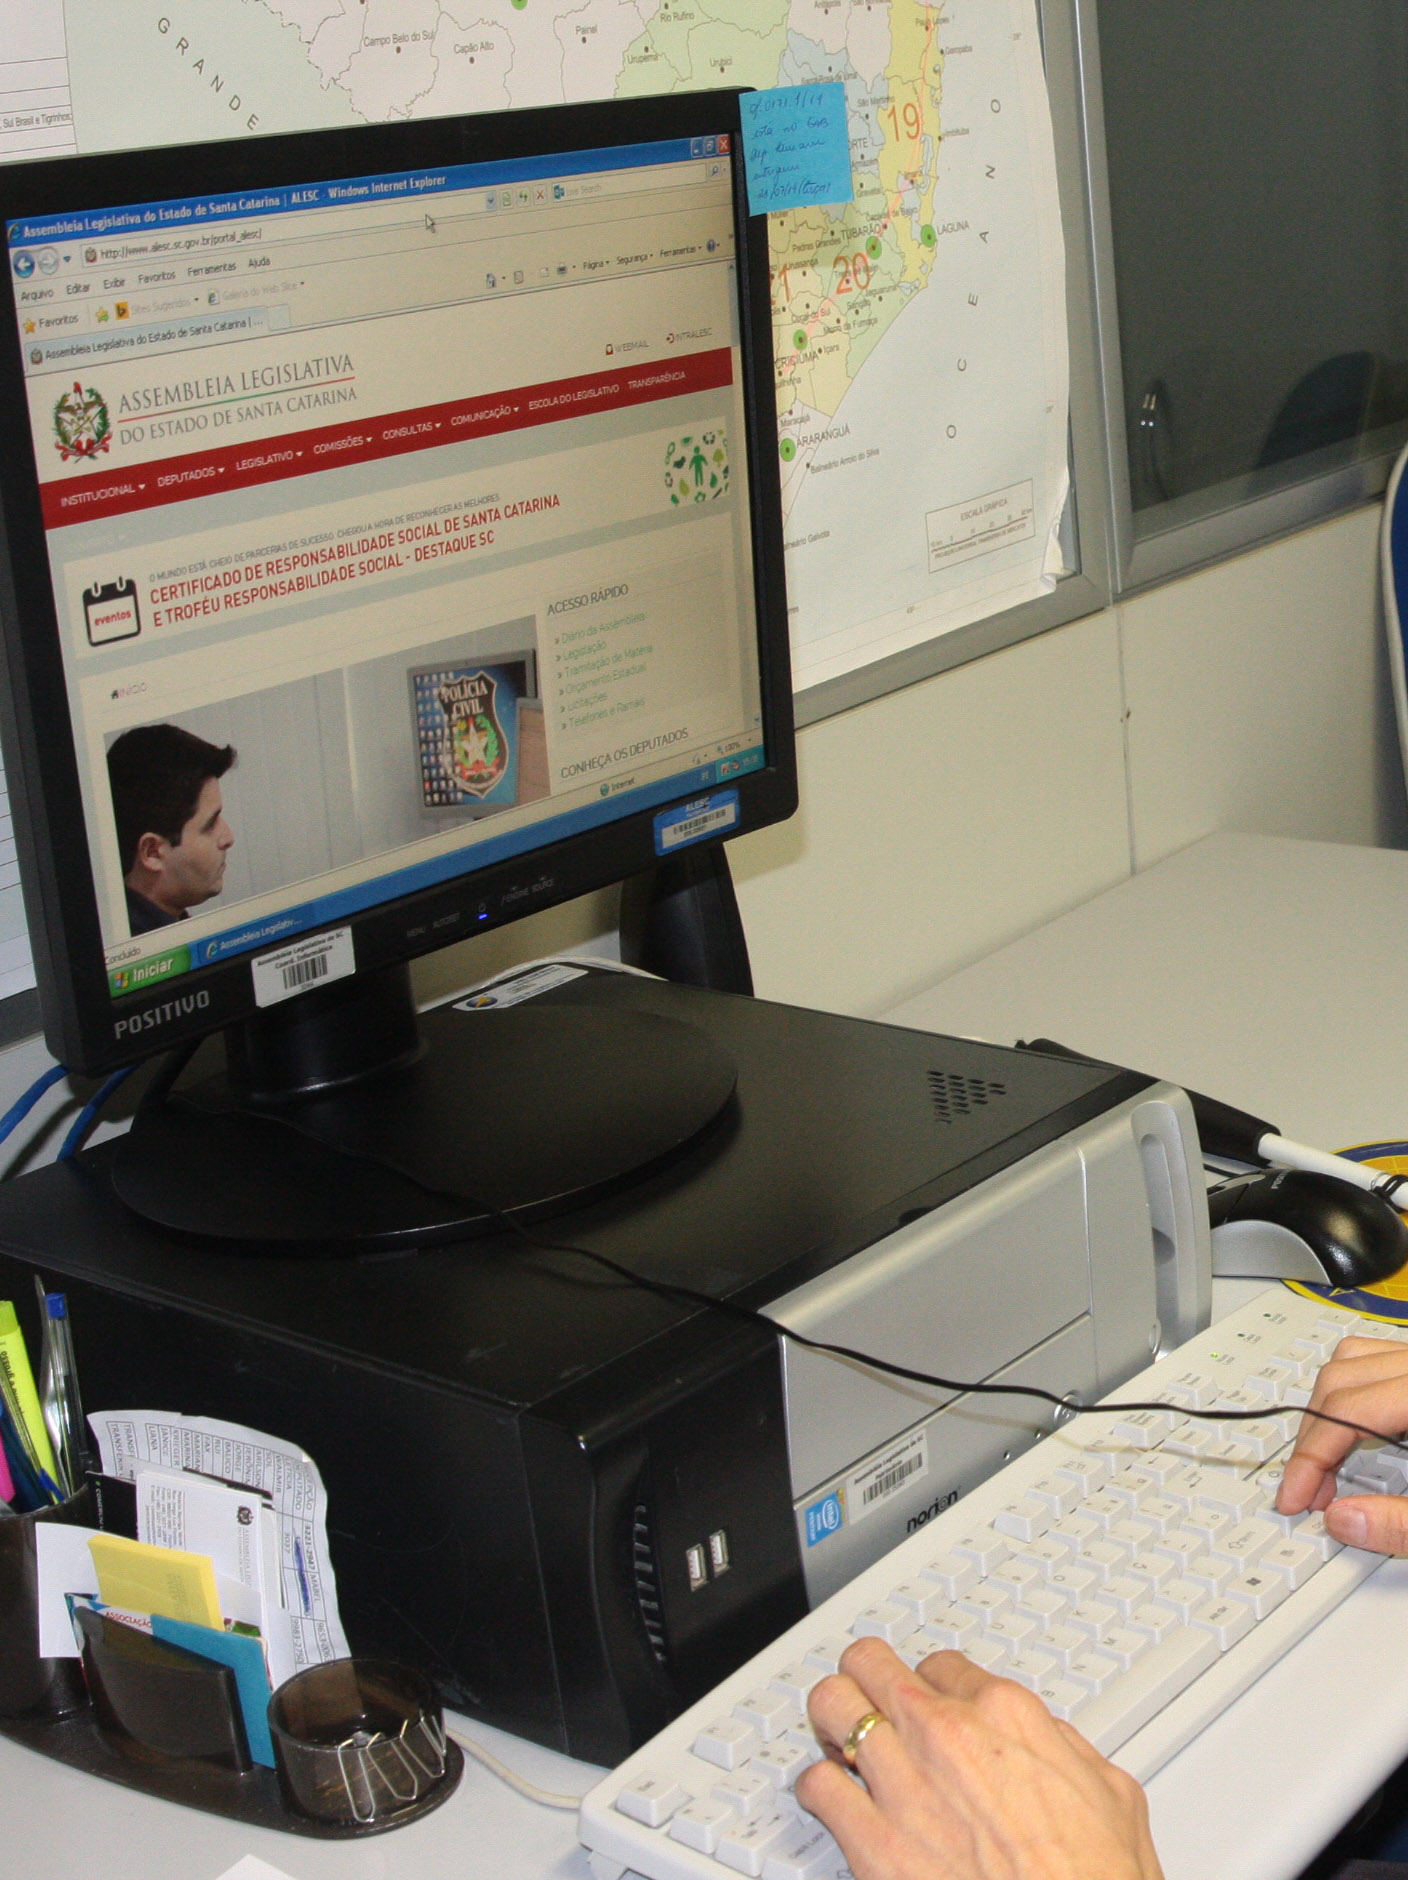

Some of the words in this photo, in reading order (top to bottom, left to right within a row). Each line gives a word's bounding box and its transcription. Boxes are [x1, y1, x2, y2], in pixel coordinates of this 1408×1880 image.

[575, 24, 598, 35] Painel
[660, 13, 672, 23] Rio
[672, 11, 695, 22] Rufino
[364, 34, 391, 48] Campo
[392, 33, 409, 44] Belo
[411, 32, 421, 42] do
[422, 30, 435, 41] Sul
[453, 43, 478, 55] Capão
[480, 41, 495, 51] Alto
[627, 53, 659, 66] Urupema
[710, 57, 733, 68] Urubici
[157, 17, 260, 131] GRANDE
[3, 118, 14, 128] Sul
[15, 114, 34, 127] Brasil
[35, 117, 40, 125] e
[887, 102, 921, 143] 19
[23, 220, 84, 239] Assembleia
[85, 213, 142, 232] Legislativa
[144, 210, 157, 223] do
[159, 206, 193, 220] Estado
[195, 203, 207, 216] de
[209, 200, 238, 215] Santa
[239, 194, 281, 210] Catarina
[291, 189, 320, 205] ALESC
[328, 184, 370, 200] Windows
[371, 179, 408, 195] Internet
[410, 175, 446, 191] Explorer
[840, 223, 881, 240] TUBARÃO
[937, 220, 970, 235] LAGUNA
[583, 256, 604, 270] Página
[616, 252, 649, 266] Segurança
[659, 245, 697, 258] Ferramentas
[792, 242, 814, 252] Pedras
[815, 237, 842, 249] Grandes
[21, 288, 55, 302] Arquivo
[66, 283, 91, 295] Editar
[103, 278, 125, 290] Exibir
[138, 271, 176, 284] Favoritos
[187, 261, 237, 277] Ferramentas
[248, 256, 271, 270] Ajuda
[832, 252, 870, 295] 20
[39, 314, 79, 328] Favoritos
[821, 307, 831, 317] Sul
[852, 317, 878, 331] Fumaça
[45, 343, 91, 360] Assembleia
[92, 335, 135, 352] Legislativa
[137, 332, 147, 344] do
[148, 328, 176, 343] Estado
[178, 327, 188, 339] de
[189, 321, 213, 336] Santa
[214, 316, 247, 332] Catarina
[614, 340, 650, 354] WEBMAIL
[675, 326, 713, 342] INTRALESC
[823, 344, 840, 355] Içara
[118, 375, 235, 414] ASSEMBLEIA
[242, 354, 355, 391] LEGISLATIVA
[120, 427, 145, 445] DO
[150, 414, 209, 440] ESTADO
[213, 410, 233, 426] DE
[237, 402, 284, 422] SANTA
[287, 387, 358, 413] CATARINA
[780, 413, 811, 428] Maracajá
[60, 483, 135, 508] INSTITUCIONAL
[157, 466, 216, 487] DEPUTADOS
[236, 450, 294, 471] LEGISLATIVO
[313, 435, 364, 455] COMISSÕES
[382, 421, 433, 441] CONSULTAS
[450, 404, 512, 427] COMUNICAÇÃO
[528, 396, 559, 410] ESCOLA
[559, 393, 572, 405] DO
[572, 384, 619, 403] LEGISLATIVO
[627, 370, 686, 390] TRANSPARÊNCIA
[796, 423, 850, 448] ARARANGUÁ
[810, 459, 840, 475] Balneário
[840, 455, 857, 467] Arroio
[866, 448, 880, 459] Silva
[960, 507, 983, 521] ESCALA
[150, 568, 242, 604] CERTIFICADO
[244, 564, 263, 582] DE
[266, 530, 395, 577] RESPONSABILIDADE
[397, 520, 442, 544] SOCIAL
[444, 516, 460, 531] DE
[463, 507, 501, 529] SANTA
[503, 494, 560, 520] CATARINA
[157, 566, 187, 581] MUNDO
[188, 561, 207, 575] ESTÁ
[209, 556, 233, 569] CHEIO
[234, 553, 245, 563] DE
[246, 543, 288, 560] PARCERIAS
[288, 540, 299, 550] DE
[300, 532, 334, 547] SUCESSO
[337, 524, 366, 538] CHEGOU
[374, 517, 394, 530] HORA
[394, 514, 405, 524] DE
[405, 504, 453, 522] RECONHECER
[453, 501, 463, 511] AS
[463, 493, 500, 508] MELHORES
[807, 529, 831, 543] Gaivota
[153, 611, 163, 627] E
[165, 595, 221, 624] TROFÉU
[224, 566, 355, 610] RESPONSABILIDADE
[358, 552, 404, 577] SOCIAL
[414, 534, 477, 563] DESTAQUE
[479, 529, 495, 546] SC
[547, 595, 589, 616] ACESSO
[590, 583, 629, 605] RÁPIDO
[94, 609, 132, 626] eventos
[441, 679, 488, 703] POLÍCIA
[452, 700, 484, 719] CIVIL
[560, 754, 612, 779] CONHEÇA
[613, 747, 628, 761] OS
[629, 727, 689, 755] DEPUTADOS
[611, 777, 635, 792] Internet
[219, 928, 261, 951] Assembleia
[104, 945, 142, 967] Concluído
[132, 957, 175, 982] Iniciar
[114, 990, 210, 1040] POSITIVO
[149, 1425, 158, 1451] LIANA
[161, 1427, 169, 1457] JANICE
[172, 1428, 180, 1467] KRIEGER
[182, 1431, 191, 1469] MARINA
[254, 1449, 263, 1490] ARILSON
[275, 1455, 283, 1494] WALMIR
[284, 1456, 292, 1491] LETÍCIA
[907, 1489, 959, 1534] norion
[304, 1525, 317, 1572] 3221-2947
[310, 1574, 321, 1602] MABEL
[105, 1611, 152, 1628] ASSOCIAÇÃO
[294, 1618, 305, 1665] 9983-2750
